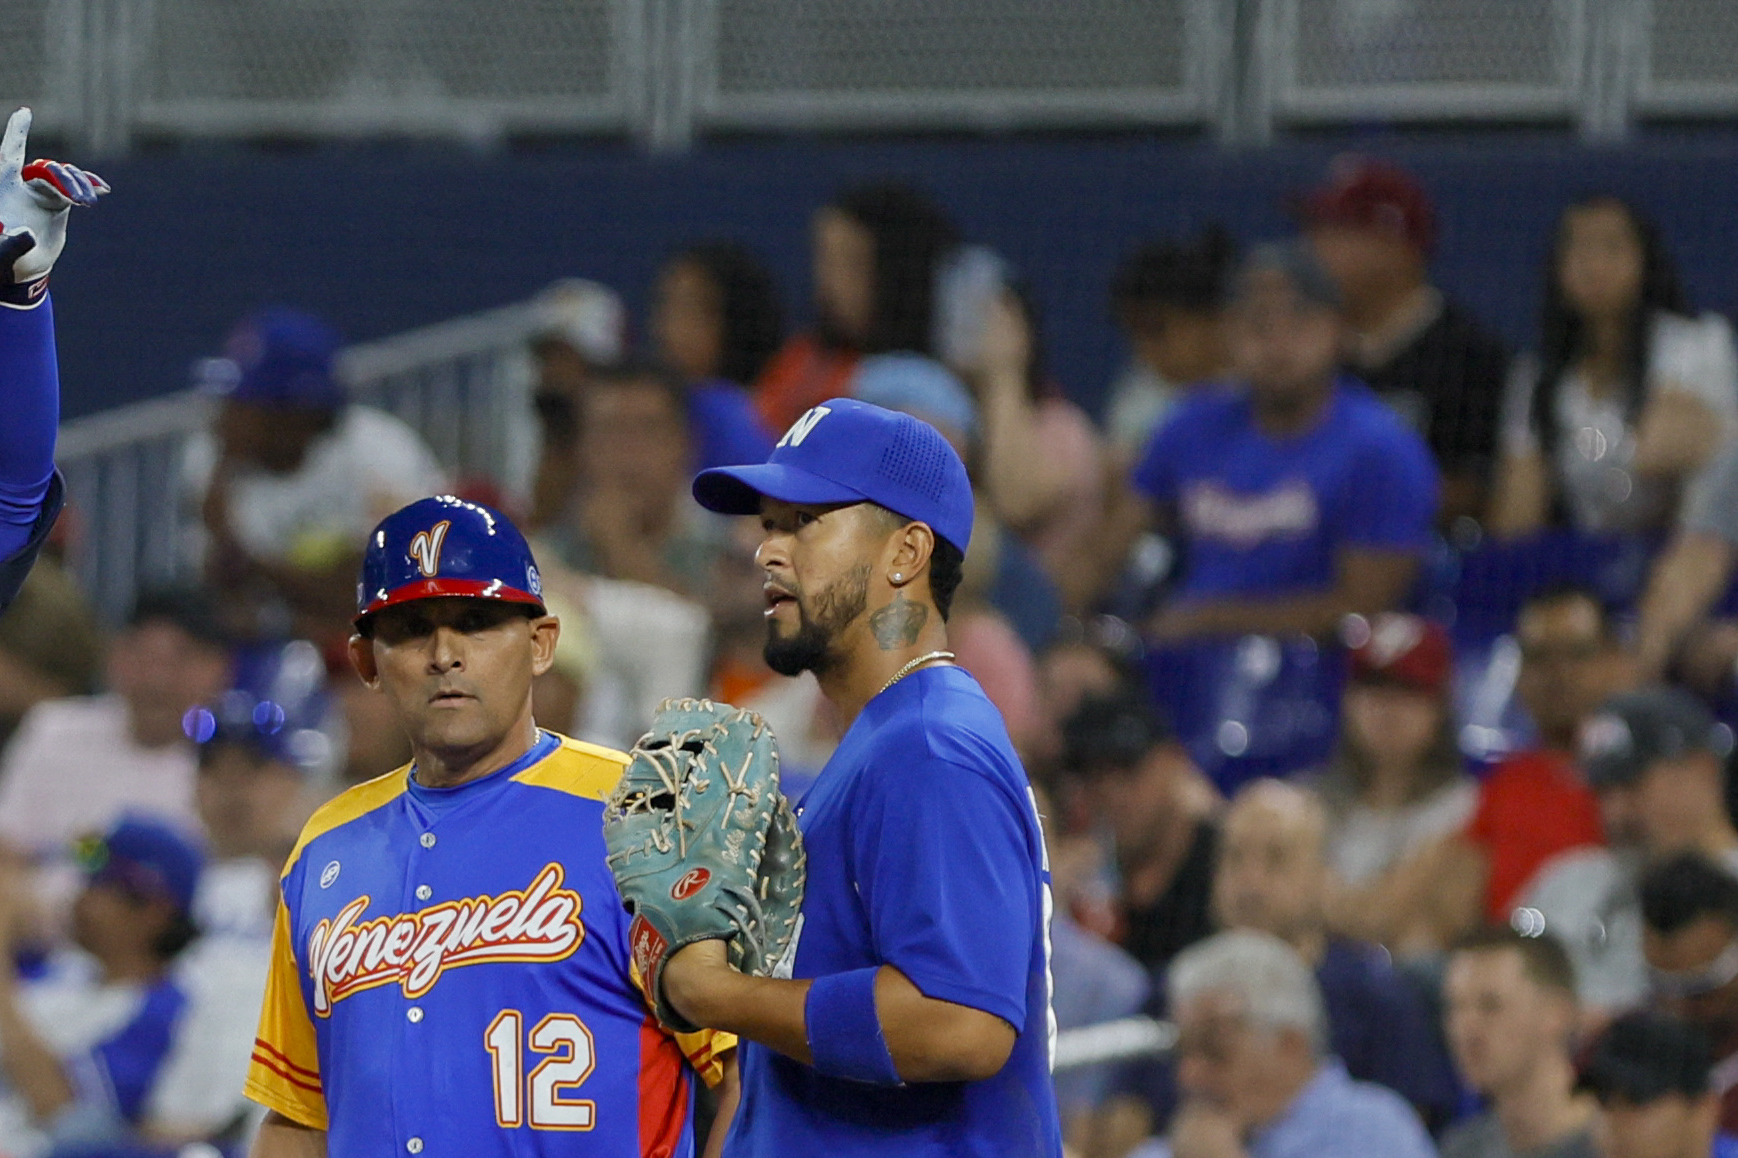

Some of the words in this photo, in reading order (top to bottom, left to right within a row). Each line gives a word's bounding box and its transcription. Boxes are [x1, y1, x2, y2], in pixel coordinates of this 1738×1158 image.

[775, 406, 832, 448] N
[410, 520, 451, 577] V
[309, 867, 586, 1018] Venezuela
[484, 1008, 597, 1132] 12
